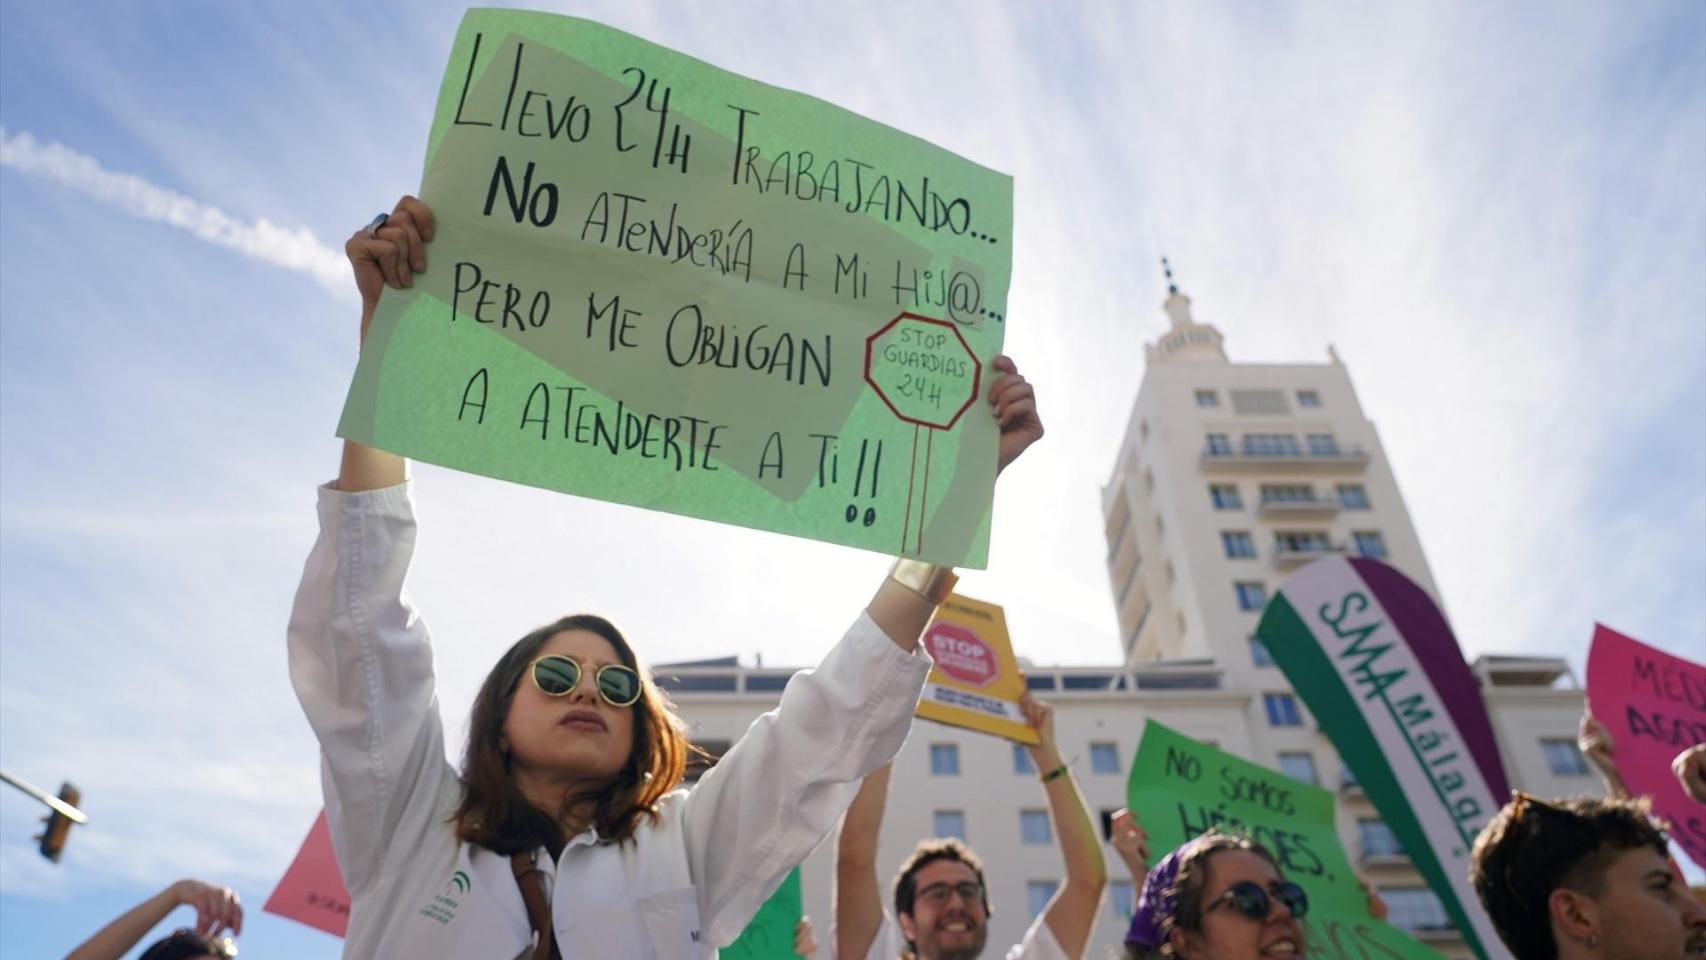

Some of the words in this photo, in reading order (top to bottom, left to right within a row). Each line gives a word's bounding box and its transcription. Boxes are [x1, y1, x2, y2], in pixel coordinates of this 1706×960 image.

[615, 67, 691, 173] 24H
[727, 104, 997, 243] TRABAJANDO...
[483, 155, 559, 227] NO
[783, 243, 808, 291] A
[452, 262, 551, 332] PERO
[586, 292, 642, 351] ME
[900, 327, 947, 350] STOP
[883, 344, 968, 379] GUARDIAS
[897, 374, 941, 409] 24H
[457, 367, 489, 425] A
[520, 382, 728, 471] ATENDERTE
[758, 431, 784, 479] A
[931, 633, 986, 659] STOP
[1165, 745, 1201, 782] NO
[1220, 765, 1296, 817] SOMOS
